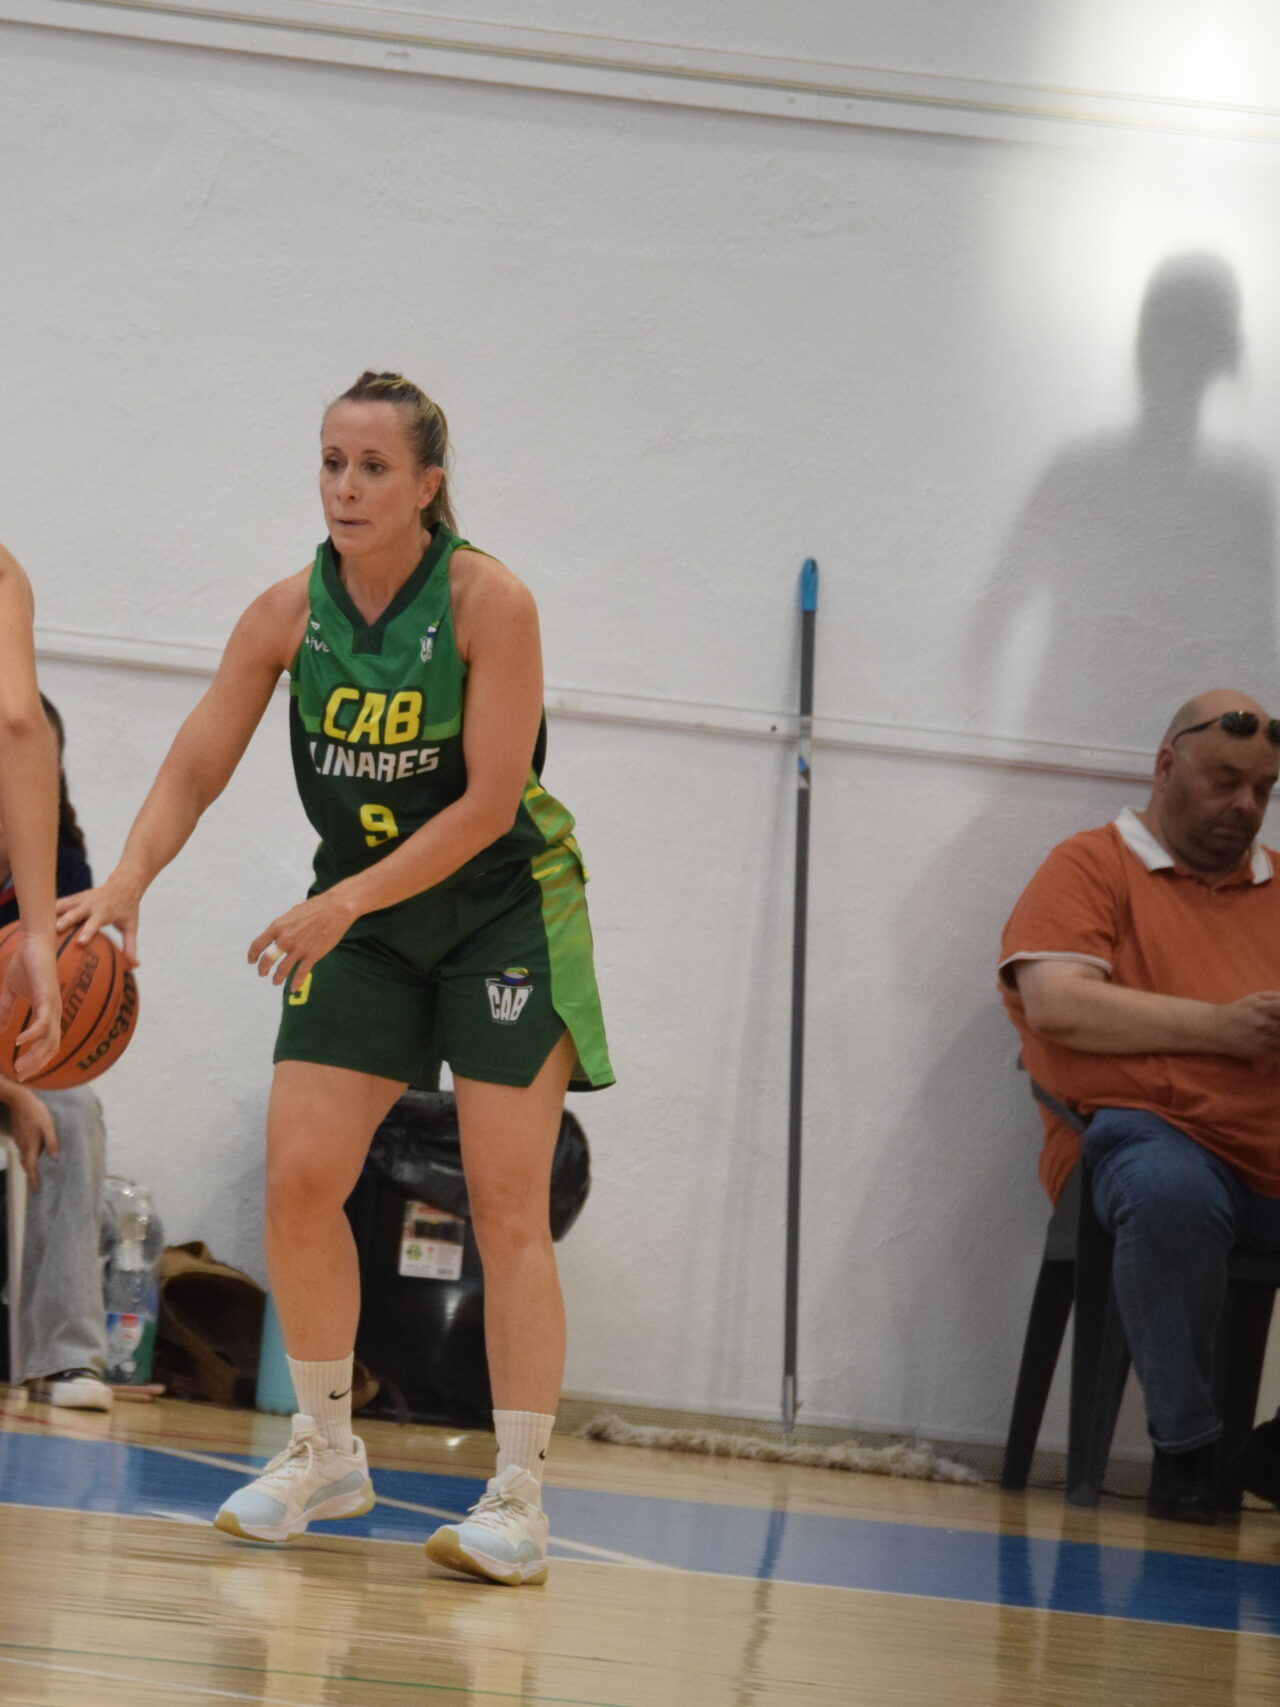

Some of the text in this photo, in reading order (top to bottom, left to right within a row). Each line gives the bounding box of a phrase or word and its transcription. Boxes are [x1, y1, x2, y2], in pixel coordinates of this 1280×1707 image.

[323, 687, 423, 745] CAB
[309, 741, 441, 783] LINARES
[360, 803, 399, 848] 9
[488, 984, 530, 1021] CAB
